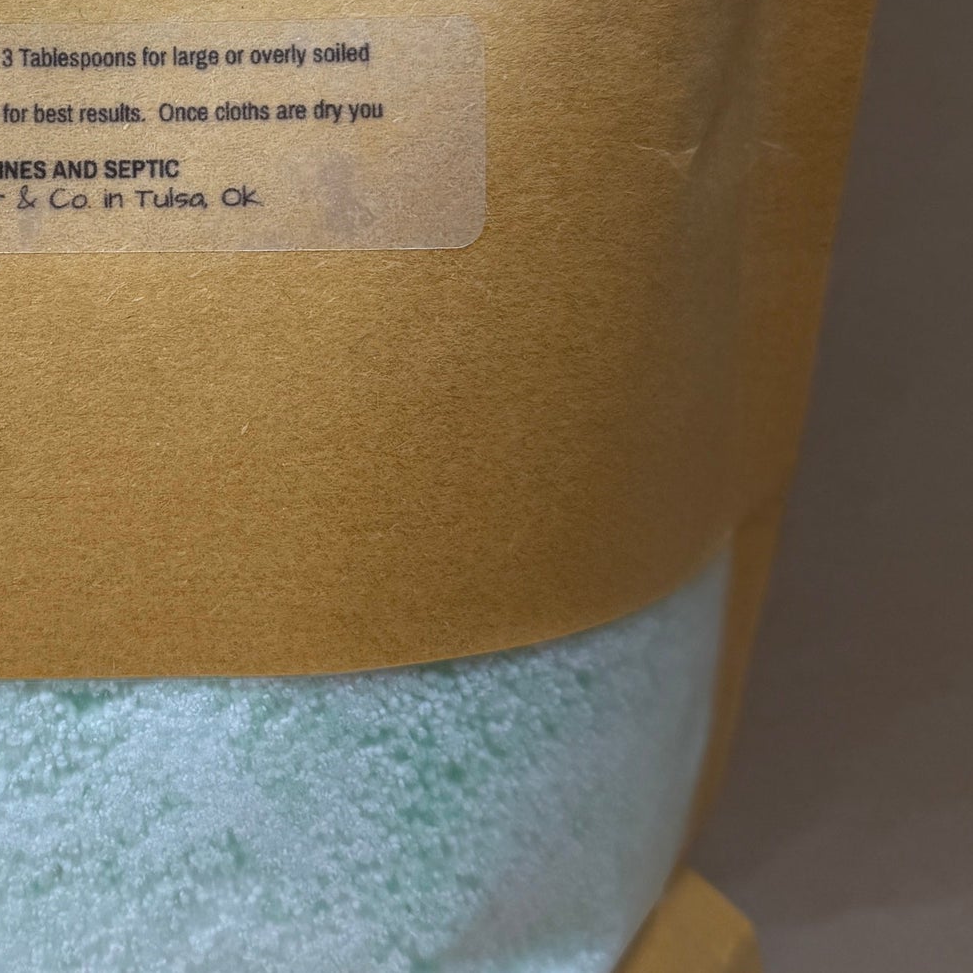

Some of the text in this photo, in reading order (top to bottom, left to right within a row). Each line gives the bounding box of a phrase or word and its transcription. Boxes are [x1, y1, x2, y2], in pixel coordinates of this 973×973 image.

[2, 48, 13, 67] 3
[19, 47, 136, 69] Tablespoons
[142, 46, 167, 67] for
[173, 45, 218, 69] large
[225, 49, 243, 65] or
[250, 44, 306, 66] overly
[313, 43, 370, 63] soiled
[2, 104, 28, 123] for
[34, 103, 74, 123] best
[79, 103, 145, 123] results.
[158, 103, 208, 122] Once
[214, 101, 269, 121] cloths
[275, 104, 307, 121] are
[313, 100, 343, 123] dry
[348, 102, 384, 123] you
[53, 160, 97, 179] AND
[104, 159, 180, 178] SEPTIC
[17, 185, 36, 209] &
[104, 188, 123, 208] in
[135, 187, 208, 209] Tulsa,
